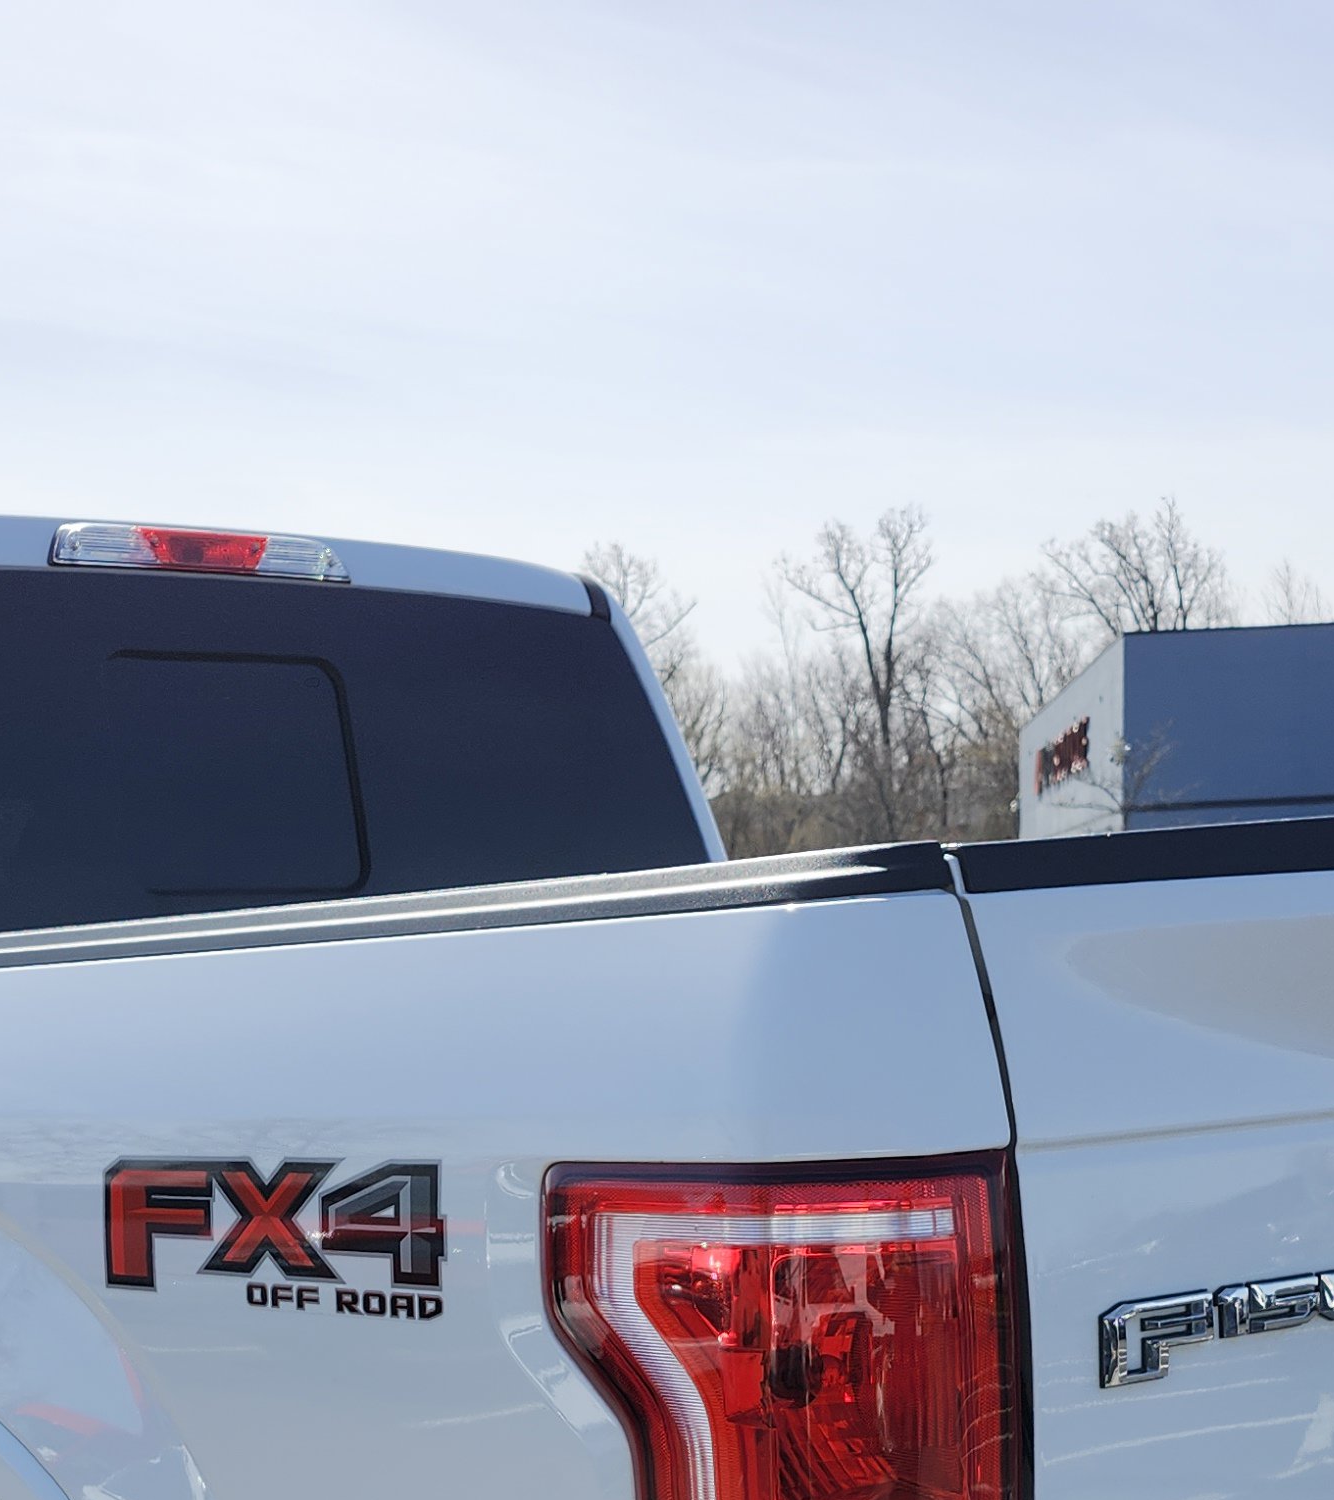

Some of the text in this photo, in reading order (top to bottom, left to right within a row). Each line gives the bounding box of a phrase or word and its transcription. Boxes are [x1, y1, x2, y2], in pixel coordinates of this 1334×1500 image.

[102, 1155, 448, 1292] FX4
[246, 1281, 444, 1321] OFF ROAD
